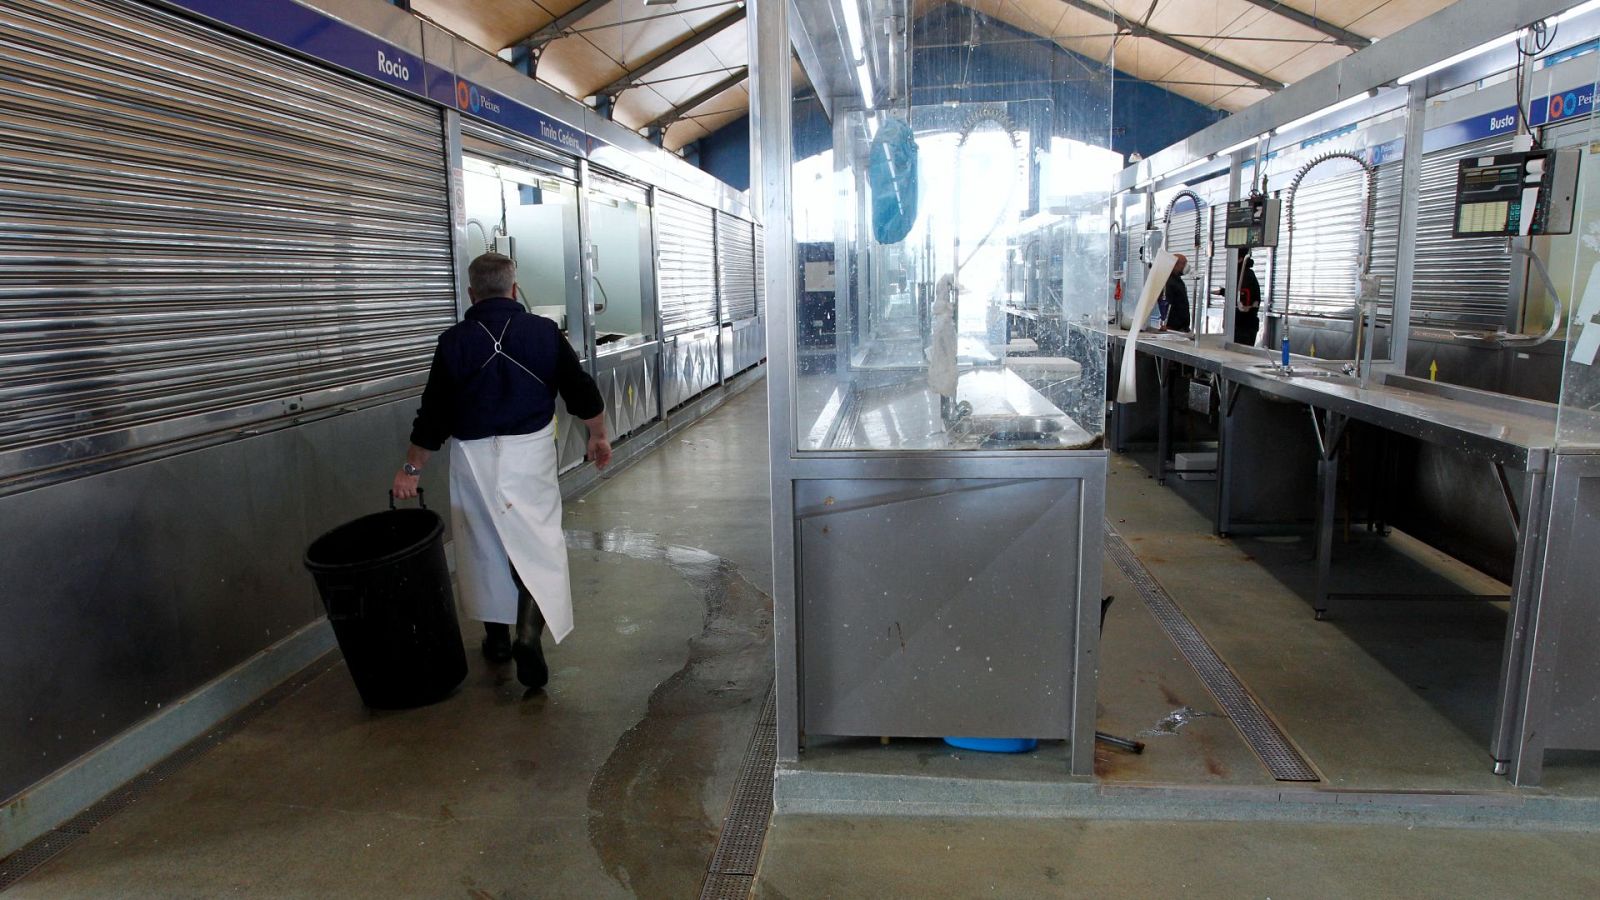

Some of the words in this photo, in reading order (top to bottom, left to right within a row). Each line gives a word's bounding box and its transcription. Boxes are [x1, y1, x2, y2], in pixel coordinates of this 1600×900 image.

[377, 50, 409, 81] Rocio
[480, 95, 500, 114] Peixes
[1490, 114, 1514, 131] Busto
